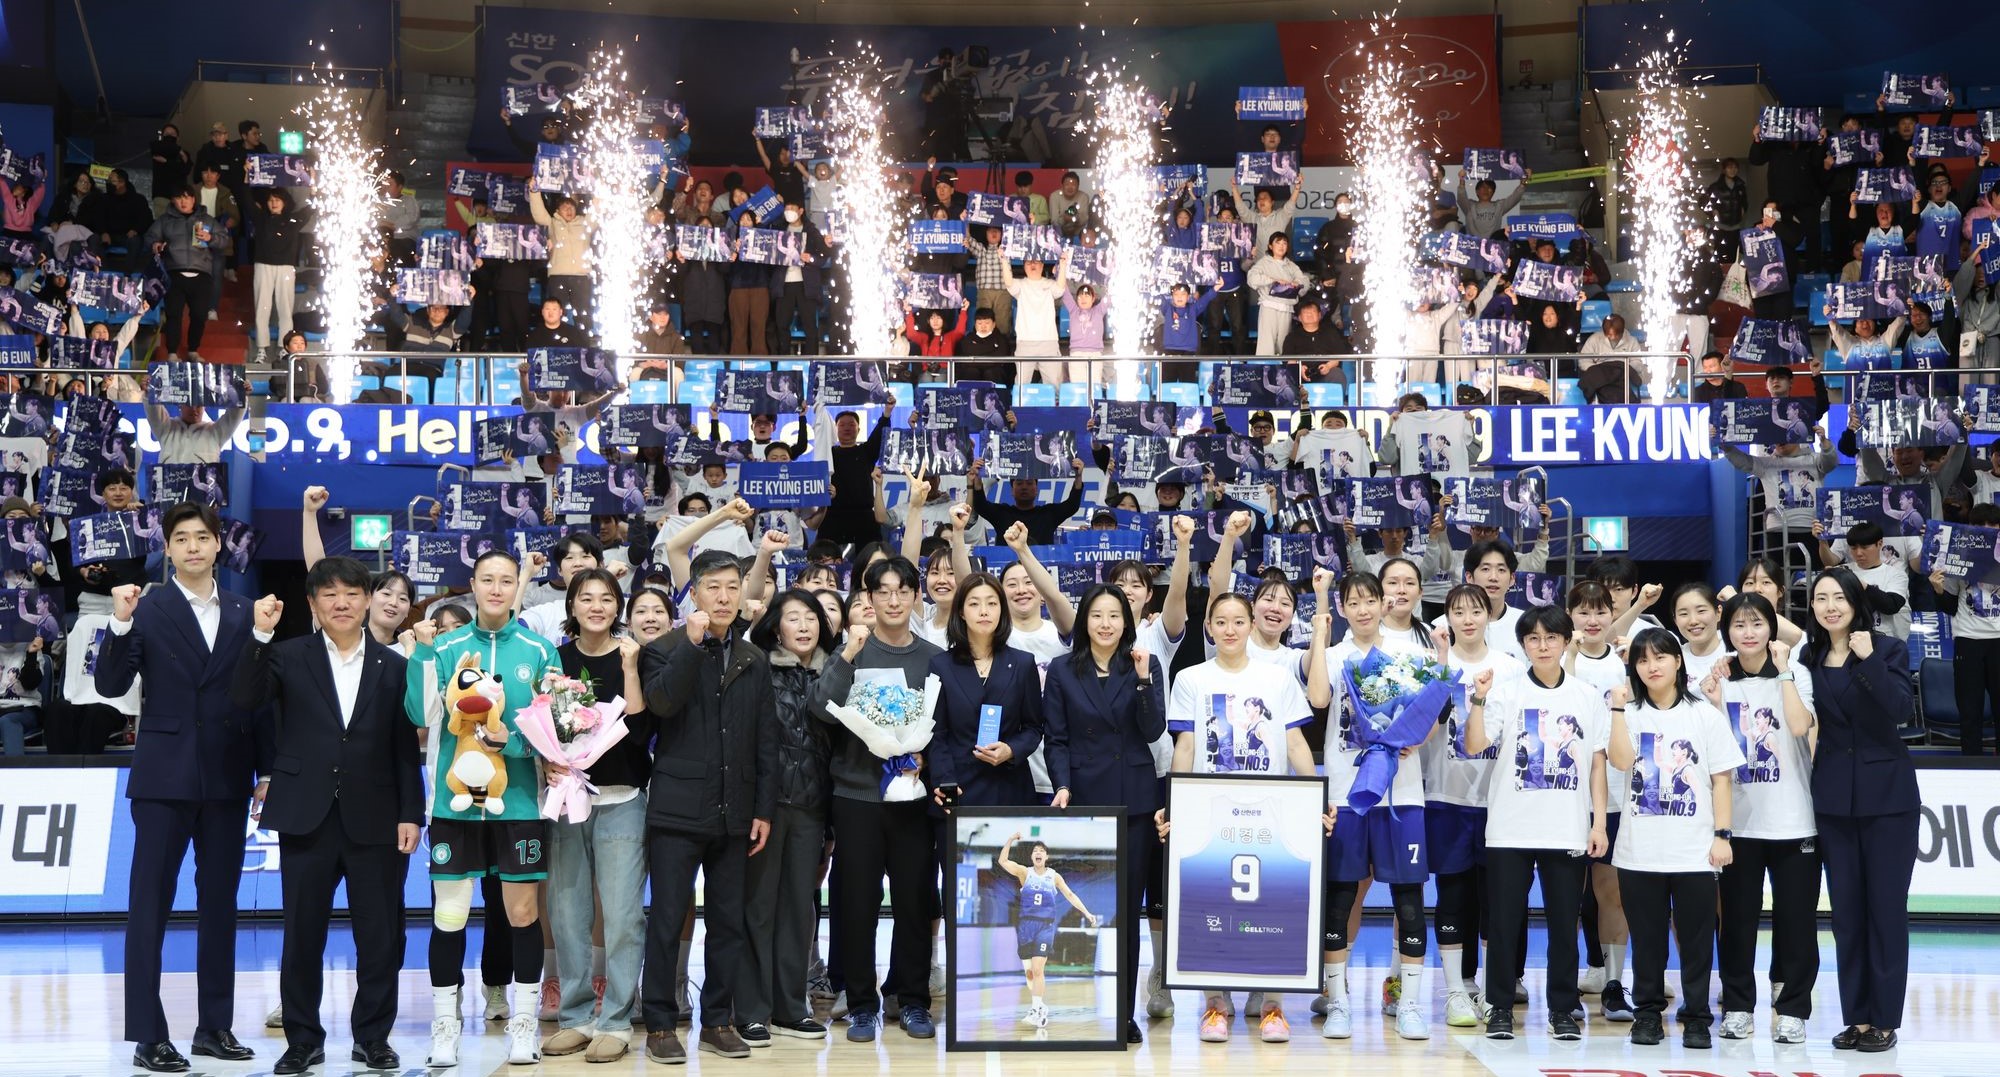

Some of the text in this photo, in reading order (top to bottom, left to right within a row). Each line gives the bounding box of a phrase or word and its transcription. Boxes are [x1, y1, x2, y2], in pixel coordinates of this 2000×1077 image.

[506, 32, 557, 51] 신한
[1242, 99, 1300, 112] LEE KYUNG EUN
[1512, 222, 1575, 234] LEE KYUNG EUN
[1939, 225, 1947, 238] 7
[923, 233, 949, 245] KYUNG
[1220, 261, 1234, 272] 21
[11, 350, 31, 364] EUN
[1916, 357, 1932, 369] 21
[1511, 408, 1580, 462] LEE
[743, 479, 825, 495] LEE KYUNG EUN
[575, 503, 590, 512] NO.9
[467, 521, 482, 530] NO.9
[1366, 517, 1381, 526] NO.9
[1471, 515, 1485, 523] NO.9
[100, 548, 116, 556] NO.9
[1949, 565, 1968, 577] NO.9
[423, 573, 440, 583] NO.9
[1245, 757, 1270, 772] NO.9
[1754, 768, 1780, 783] NO.9
[1554, 775, 1578, 791] NO.9
[1669, 802, 1696, 817] NO.9
[515, 839, 541, 864] 13
[1408, 844, 1420, 864] 7
[1231, 854, 1261, 901] 9
[1034, 893, 1043, 906] 9
[1244, 925, 1284, 933] CELLTRION
[1040, 943, 1047, 952] 9
